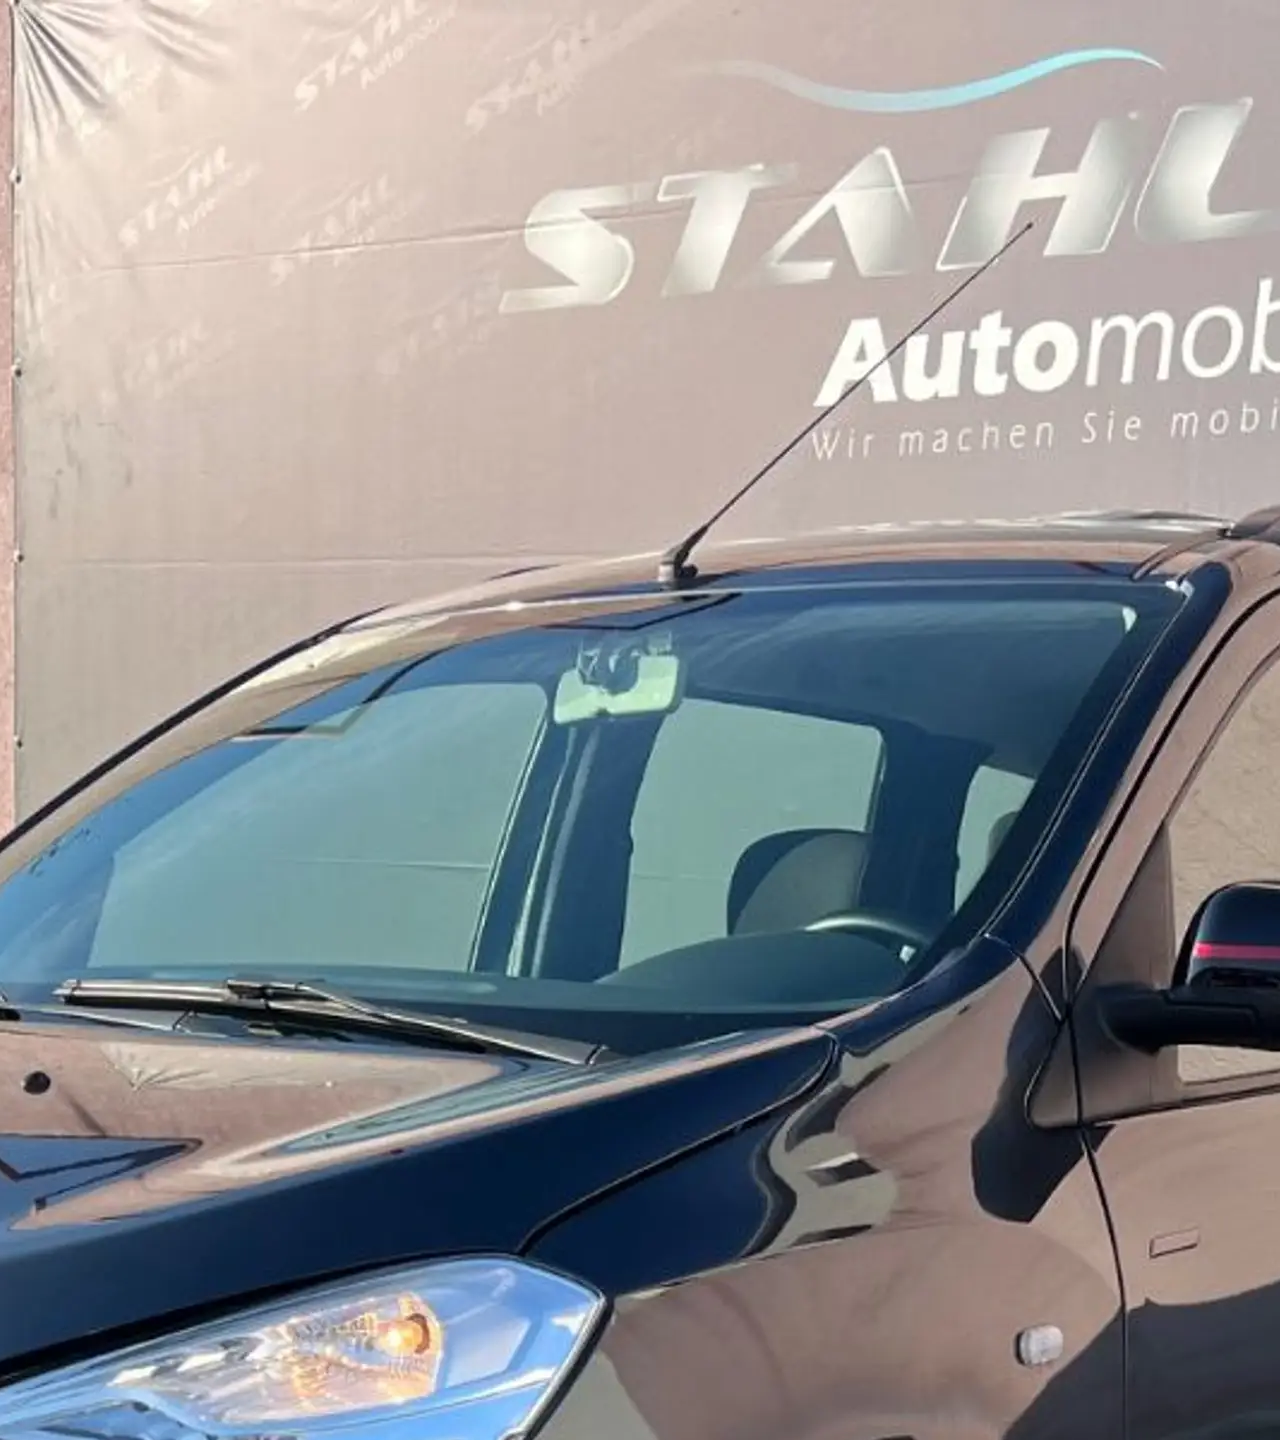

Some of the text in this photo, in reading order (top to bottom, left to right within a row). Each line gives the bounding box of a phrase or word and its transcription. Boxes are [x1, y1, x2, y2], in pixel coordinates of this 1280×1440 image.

[812, 430, 875, 461] Wir
[898, 420, 1055, 456] machen
[1081, 406, 1143, 444] Sie
